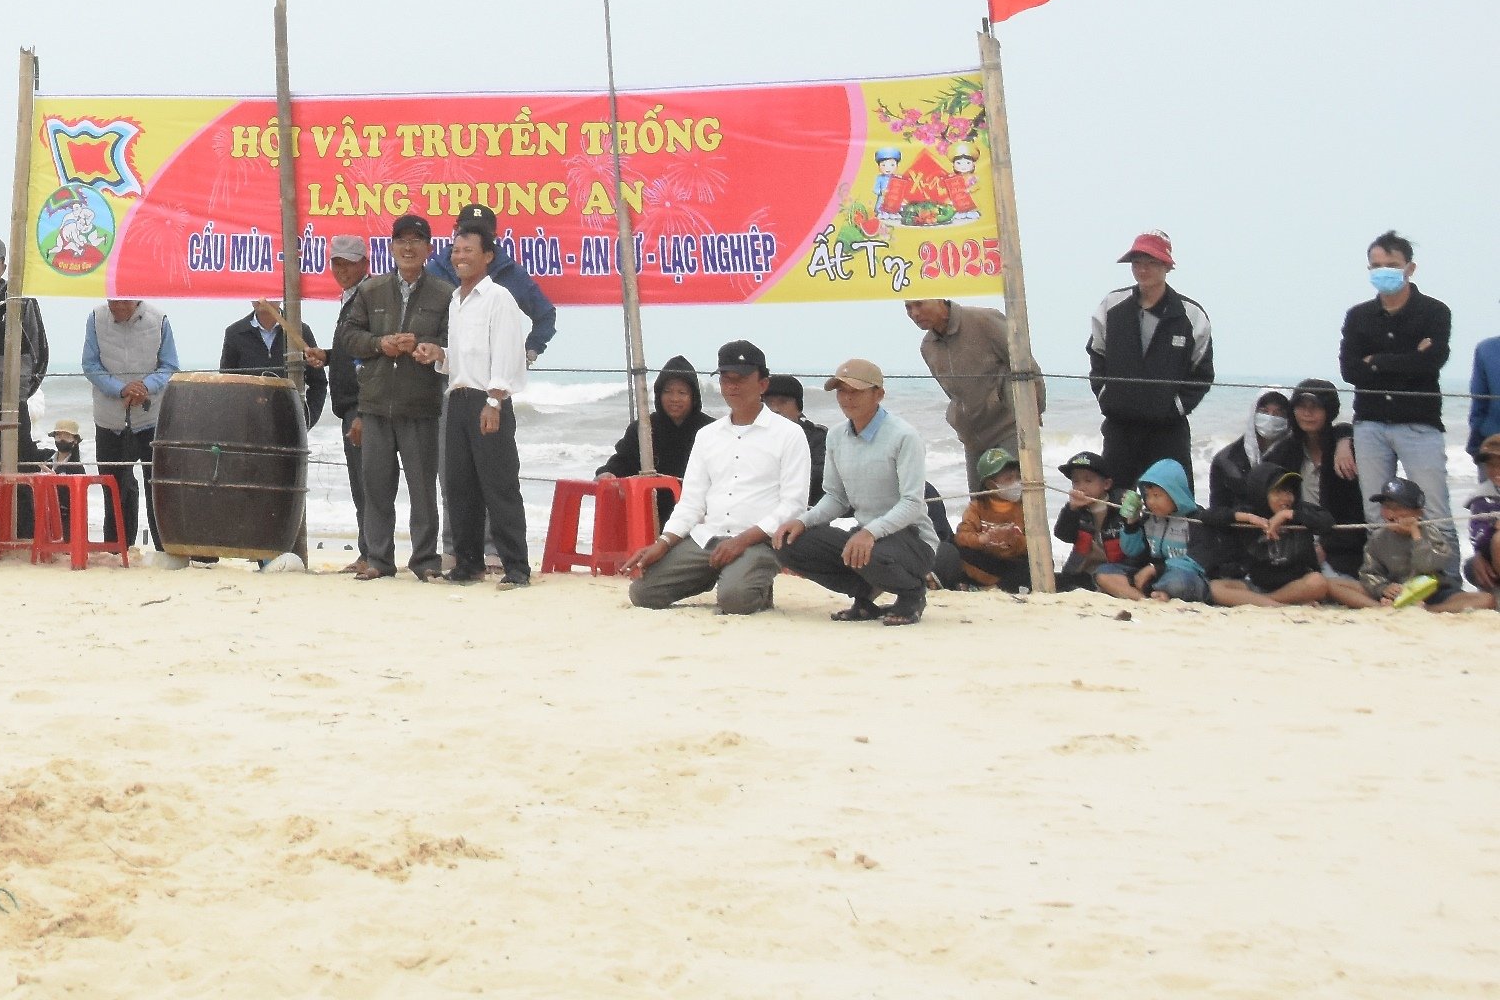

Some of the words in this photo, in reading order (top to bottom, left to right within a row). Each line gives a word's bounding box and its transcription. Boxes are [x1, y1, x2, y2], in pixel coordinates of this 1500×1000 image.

[310, 115, 387, 167] VẬT
[396, 106, 569, 158] TRUYỀN
[580, 104, 723, 155] THỐNG
[307, 174, 412, 216] LÀNG
[421, 181, 570, 217] TRUNG
[581, 180, 645, 216] AN
[519, 227, 564, 277] HÒA
[580, 235, 611, 276] AN
[659, 234, 698, 284] LẠC
[701, 224, 777, 283] NGHIỆP
[807, 223, 855, 282] Ất
[918, 236, 1002, 281] 2025
